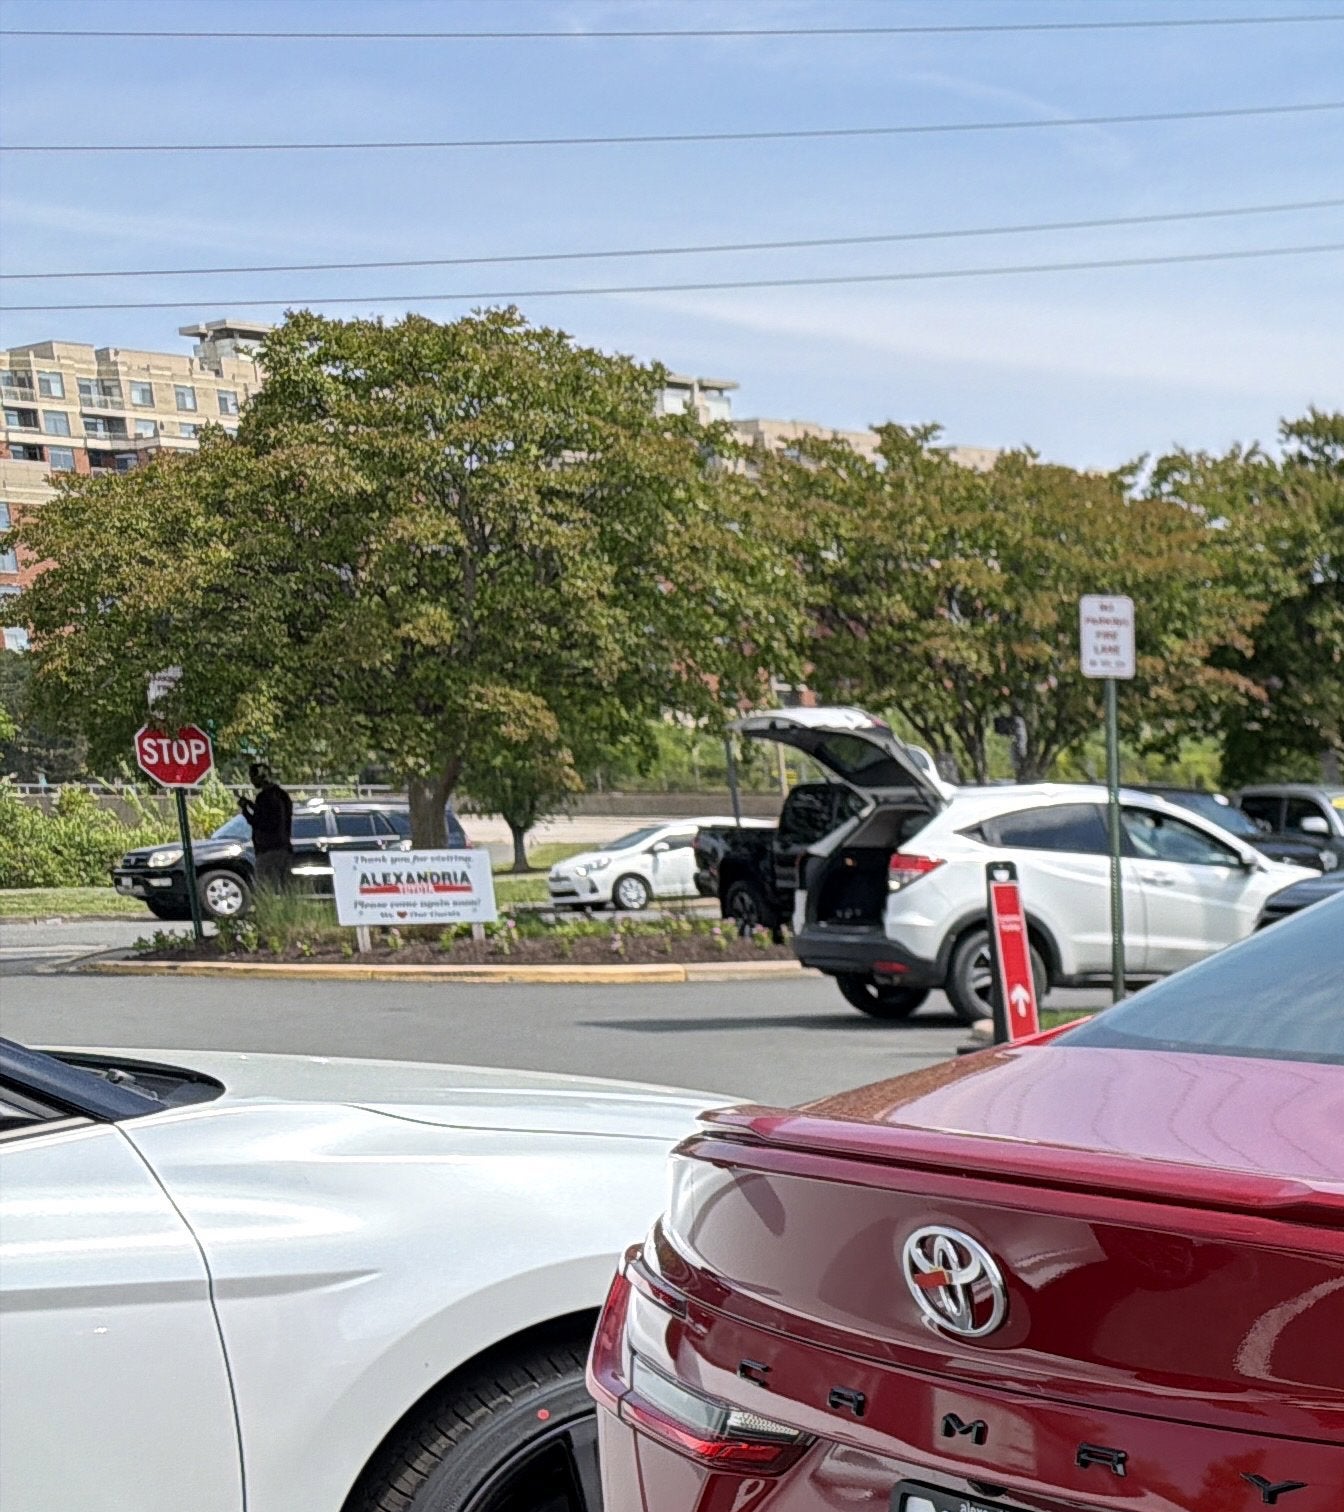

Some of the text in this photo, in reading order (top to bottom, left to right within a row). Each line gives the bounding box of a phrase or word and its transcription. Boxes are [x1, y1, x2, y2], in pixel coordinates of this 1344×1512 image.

[142, 737, 206, 765] STOP
[359, 870, 473, 887] ALEXANDRIA
[737, 1358, 1307, 1505] CAMRY
